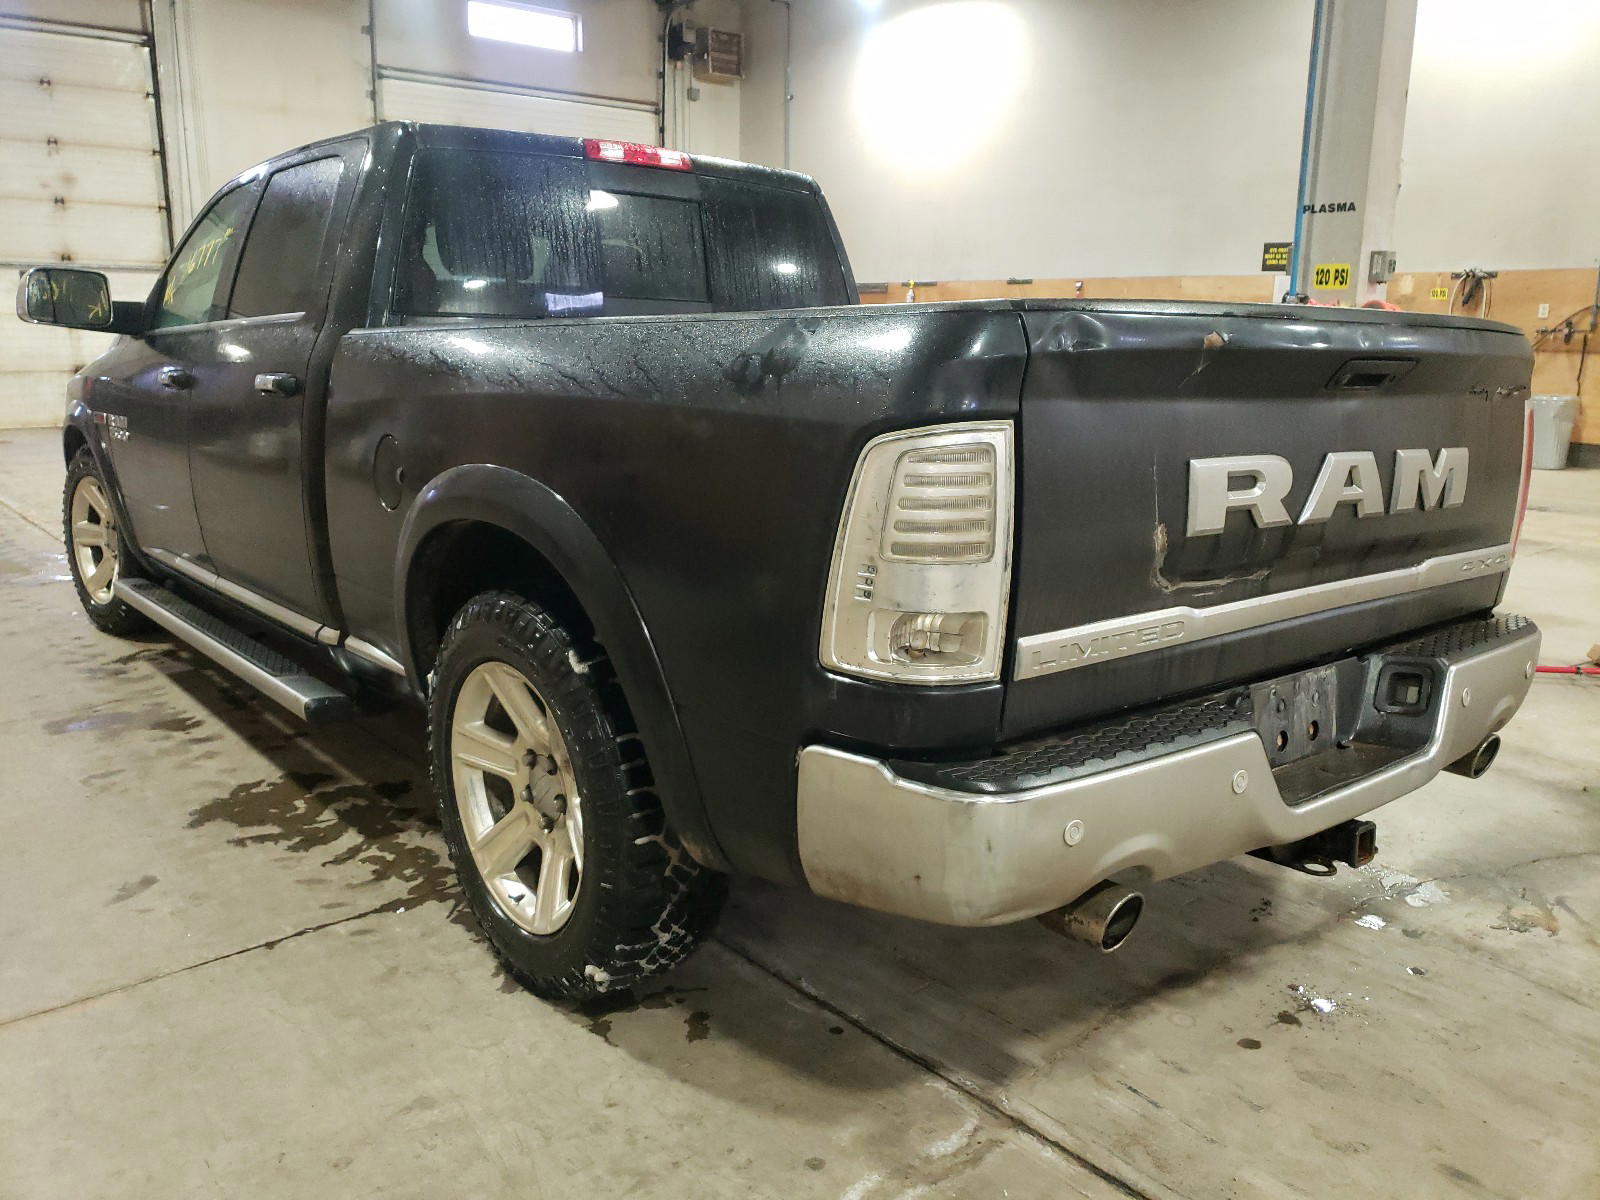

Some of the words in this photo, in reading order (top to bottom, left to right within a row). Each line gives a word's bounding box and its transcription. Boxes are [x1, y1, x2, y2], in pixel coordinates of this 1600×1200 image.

[1302, 201, 1356, 214] PLASMA
[1315, 268, 1330, 286] 120
[1333, 267, 1349, 286] PSI
[1187, 447, 1469, 537] RAM
[1031, 620, 1185, 671] LIMITED
